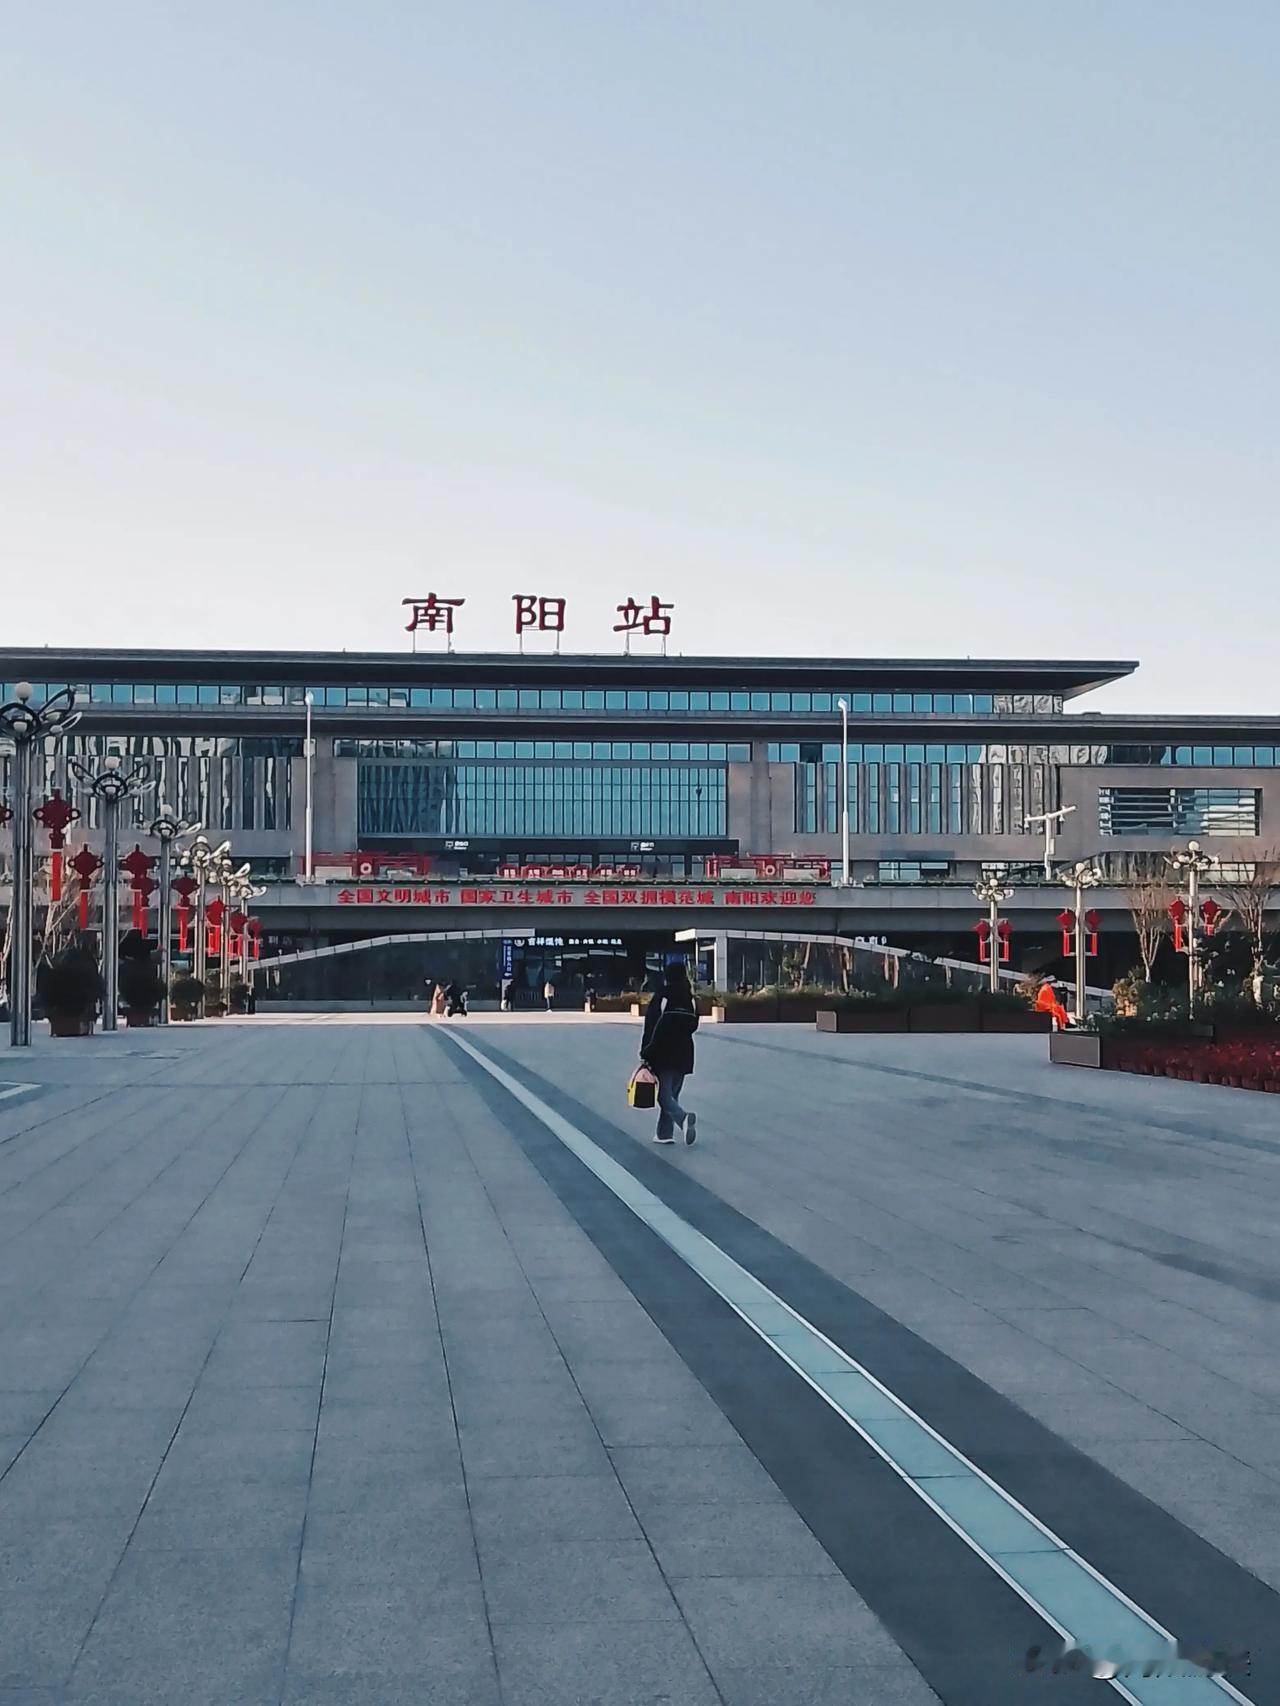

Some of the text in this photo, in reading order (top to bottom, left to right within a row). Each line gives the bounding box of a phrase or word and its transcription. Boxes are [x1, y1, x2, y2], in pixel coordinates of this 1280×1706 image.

[402, 592, 675, 635] 南阳站
[337, 888, 817, 906] 全国文明城市 国家卫生城市 全国双拥模范城 南阳欢迎您
